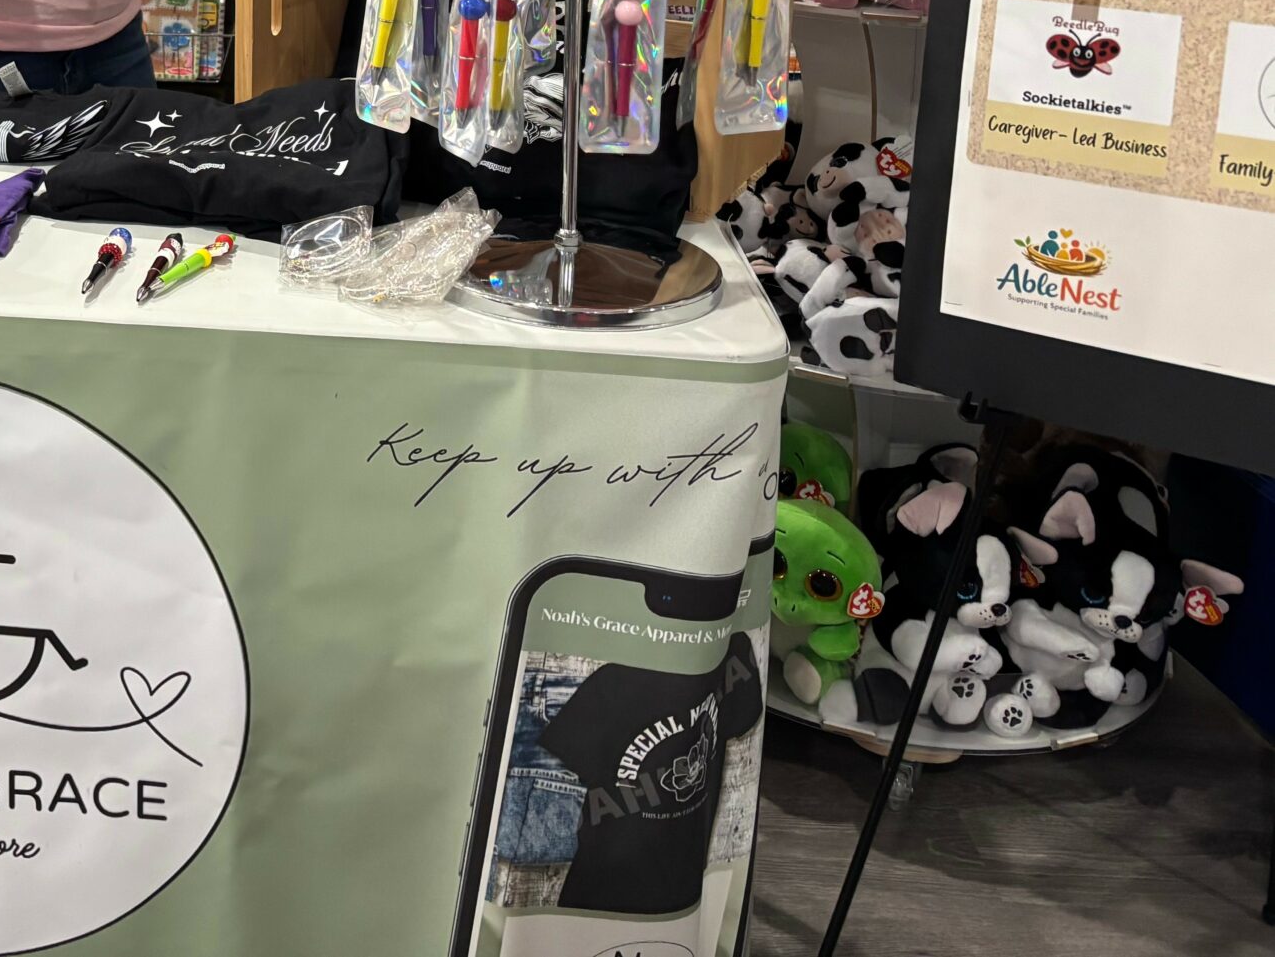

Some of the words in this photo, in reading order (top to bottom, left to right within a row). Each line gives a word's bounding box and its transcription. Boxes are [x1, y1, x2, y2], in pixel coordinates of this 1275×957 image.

[230, 112, 335, 155] Needs
[1073, 128, 1096, 147] Led
[1102, 132, 1167, 159] Business
[1219, 154, 1273, 188] Family
[996, 263, 1122, 312] AbleNest
[1007, 293, 1048, 310] Supporting
[1050, 301, 1077, 316] Special
[1078, 307, 1109, 321] Families
[367, 422, 498, 507] Keep
[506, 454, 593, 518] up
[607, 422, 758, 507] with
[853, 593, 872, 616] ty
[541, 608, 590, 629] Noah's
[593, 615, 640, 636] Grace
[643, 623, 702, 645] Apparel
[703, 630, 713, 643] &
[617, 716, 685, 781] SPECIAL
